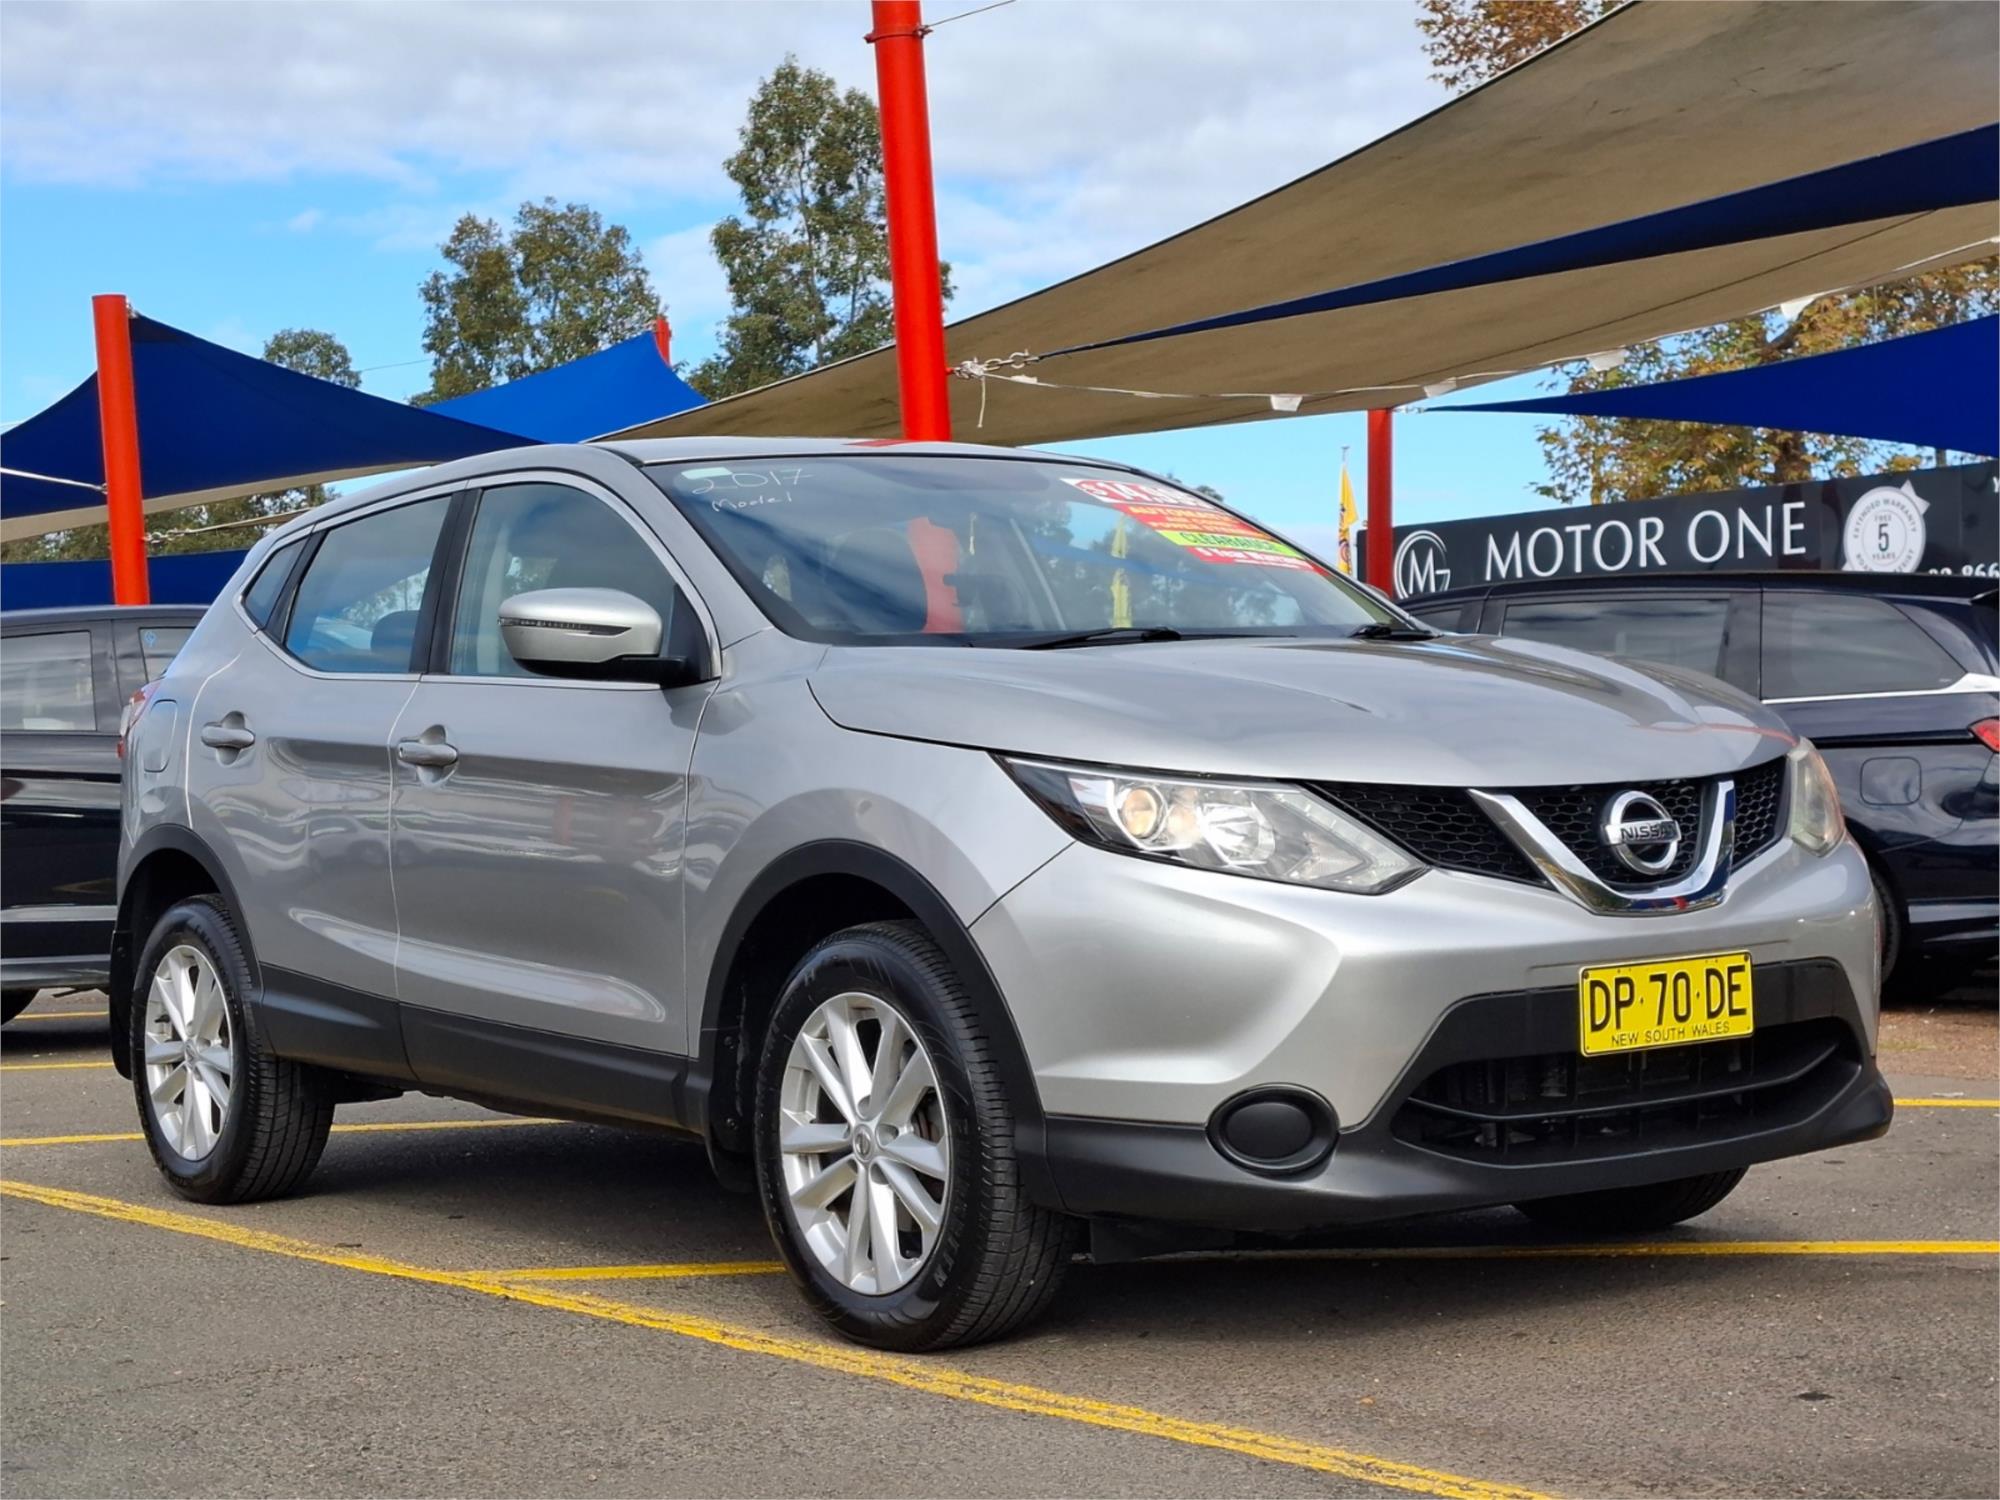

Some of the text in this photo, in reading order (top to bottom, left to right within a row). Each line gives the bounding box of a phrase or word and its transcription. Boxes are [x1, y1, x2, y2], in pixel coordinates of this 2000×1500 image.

[692, 468, 814, 495] 2017
[1485, 501, 1806, 581] MOTOR ONE
[1878, 523, 1890, 552] 5
[1612, 1021, 1731, 1047] NEW SOUTH WALES
